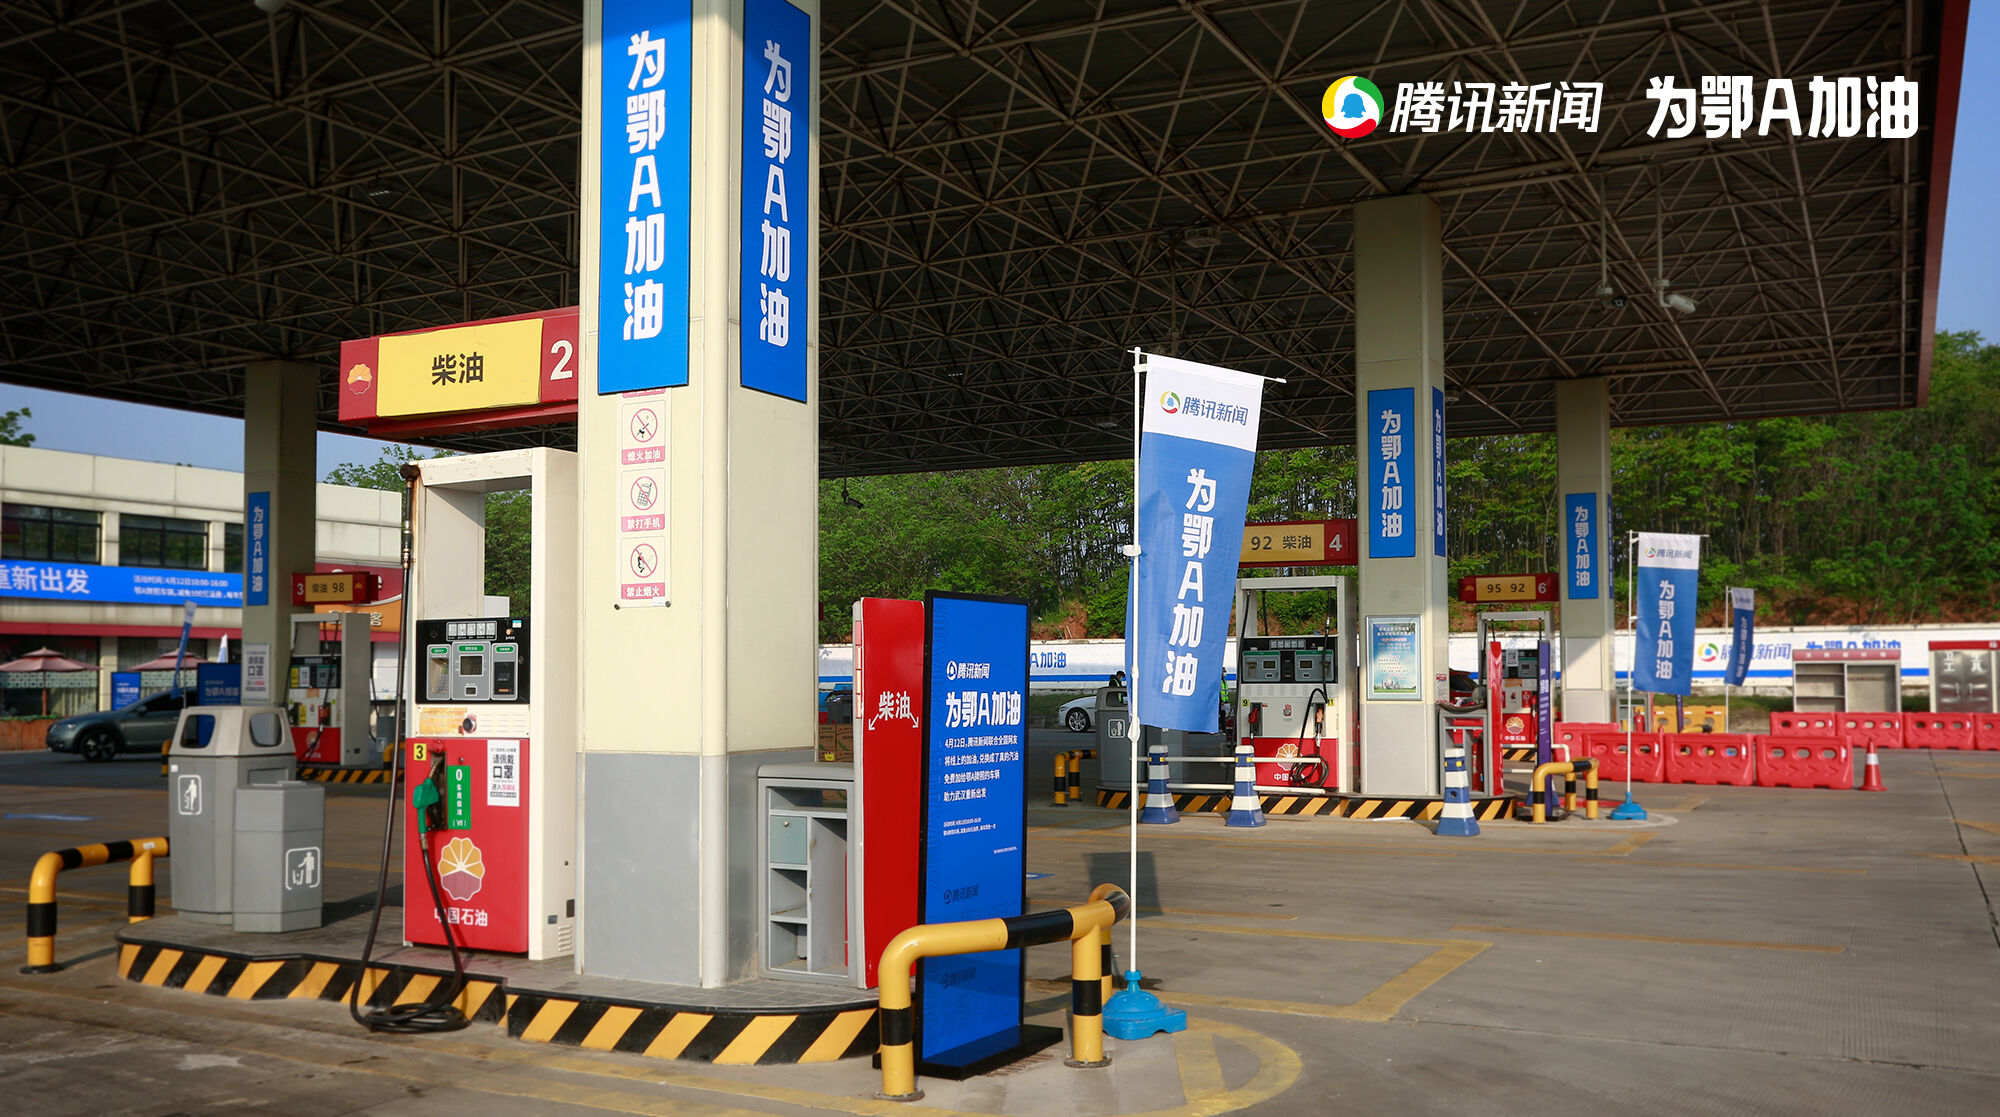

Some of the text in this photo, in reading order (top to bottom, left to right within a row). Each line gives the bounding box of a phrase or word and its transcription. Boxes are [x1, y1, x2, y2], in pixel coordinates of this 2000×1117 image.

[623, 29, 667, 341] 为鄂A加油
[759, 39, 793, 348] 为鄂A加油
[431, 352, 484, 385] 柴油
[549, 340, 573, 381] 2
[1182, 396, 1248, 426] 腾讯新闻
[1381, 409, 1403, 538] 为鄂A加油
[252, 505, 264, 593] 为鄂A加油
[1250, 535, 1312, 550] 92 柴油
[1328, 534, 1343, 552] 4
[1574, 506, 1590, 587] 为鄂A加油
[296, 583, 304, 595] 3
[332, 582, 345, 593] 98
[1162, 467, 1217, 697] 为鄂A加油
[1486, 582, 1526, 593] 95 92
[1538, 582, 1547, 594] 6
[1655, 579, 1675, 680] 为鄂A加油
[957, 662, 990, 679] 腾讯新闻
[878, 691, 911, 721] 柴油
[945, 690, 1021, 728] 为鄂A加油
[416, 744, 424, 759] 3
[455, 768, 463, 781] 0
[493, 765, 514, 779] 口罩
